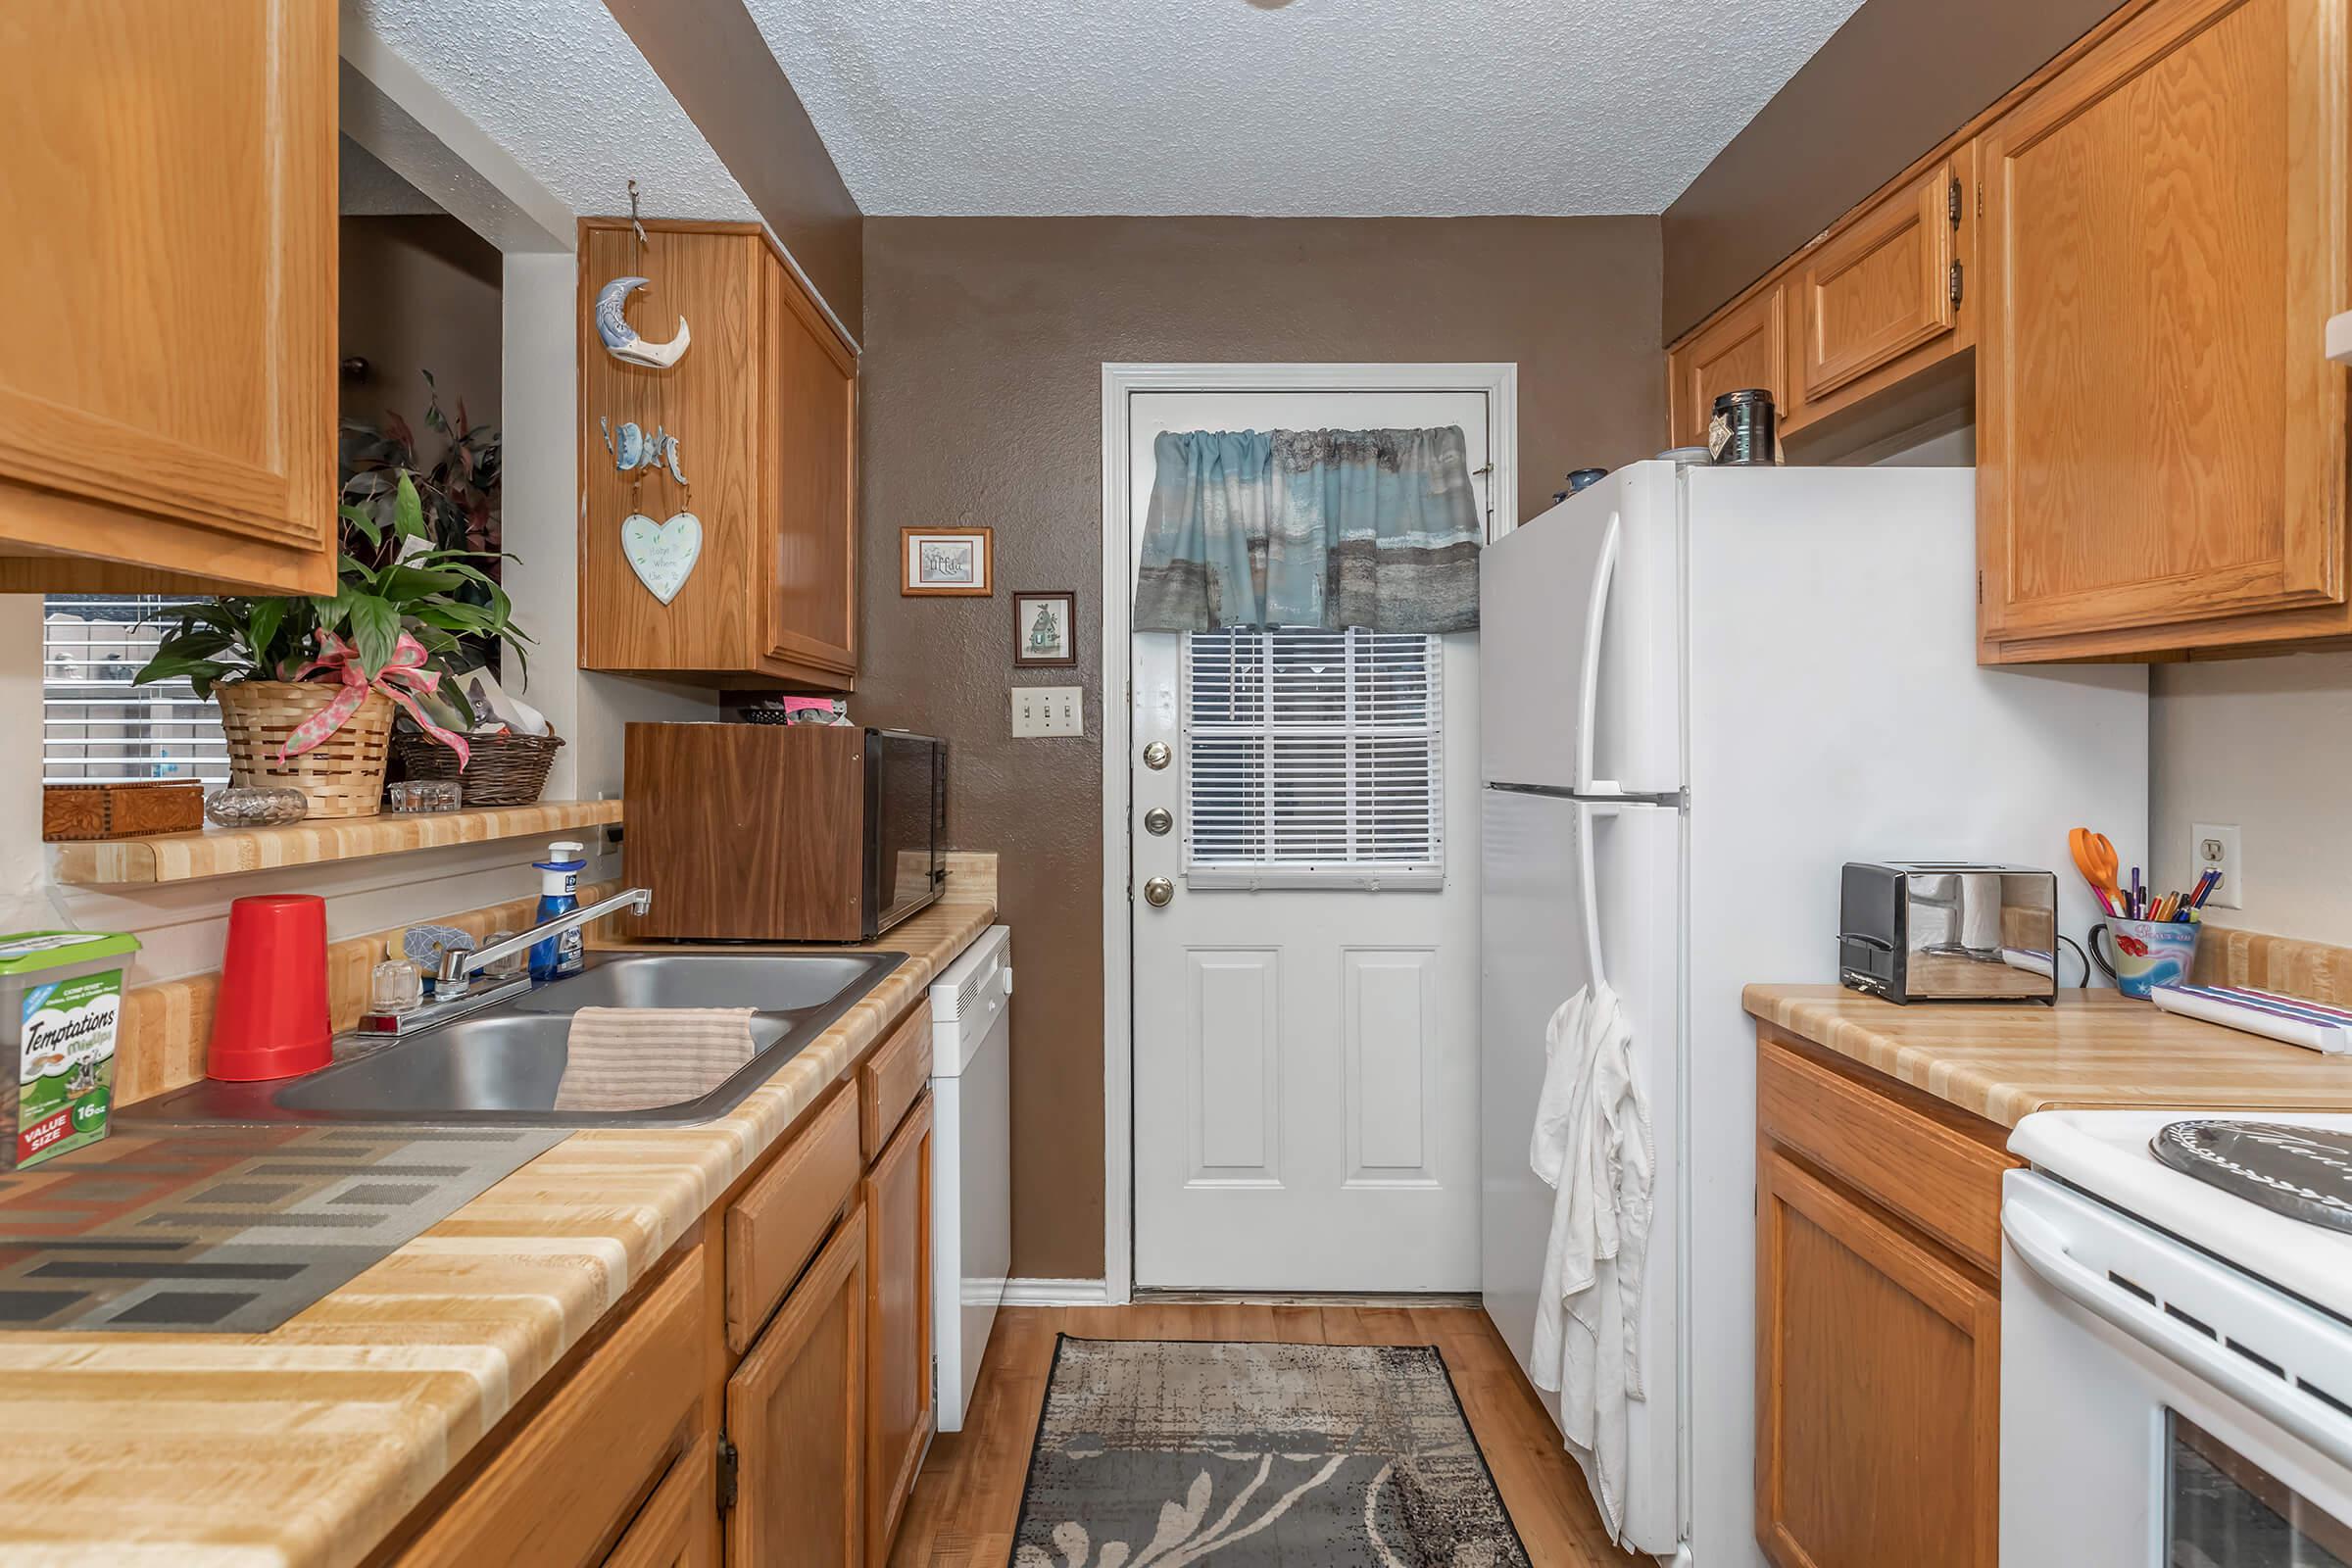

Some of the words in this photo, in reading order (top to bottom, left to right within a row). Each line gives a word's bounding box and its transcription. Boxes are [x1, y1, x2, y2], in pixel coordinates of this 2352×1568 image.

[25, 1009, 115, 1055] Temptations
[24, 1113, 68, 1144] VALUE
[30, 1127, 62, 1152] SIZE
